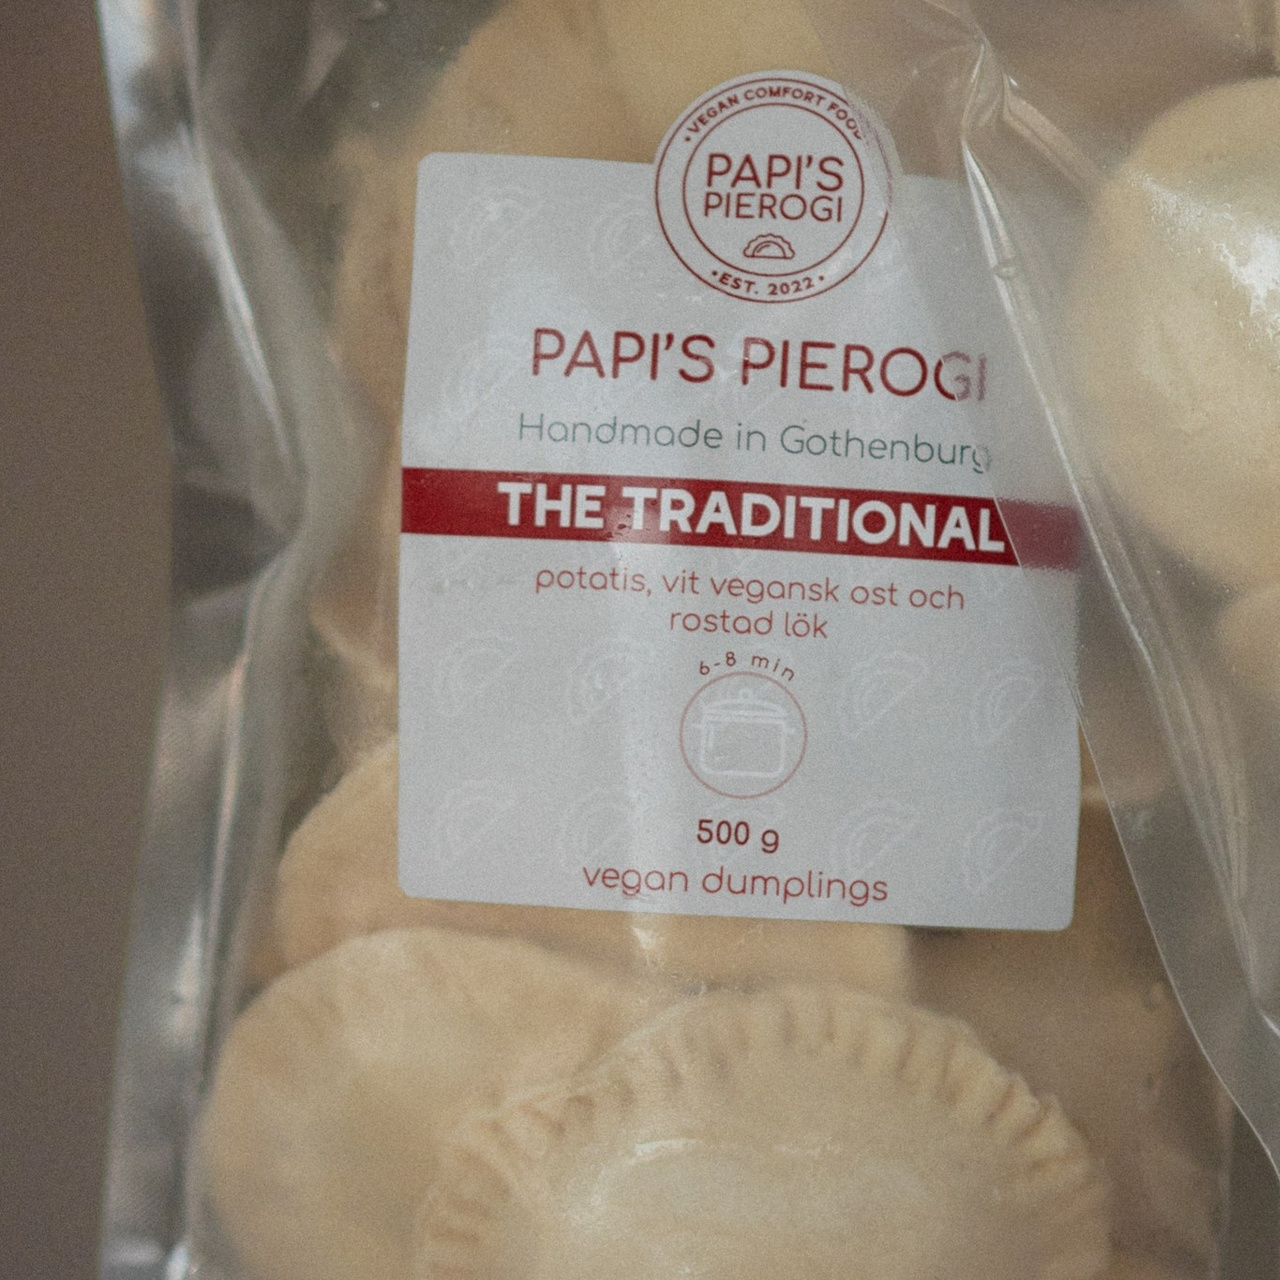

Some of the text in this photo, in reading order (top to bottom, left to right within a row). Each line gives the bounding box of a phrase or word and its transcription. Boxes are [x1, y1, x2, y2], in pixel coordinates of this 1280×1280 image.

[687, 94, 740, 134] VEGAN
[744, 87, 826, 106] COMFORT
[706, 152, 844, 192] PAPI'S
[704, 191, 843, 222] PIEROGI
[718, 271, 815, 295] EST. 2022
[531, 327, 988, 402] PAPI'S PIEROGI
[518, 413, 991, 474] Handmade in Gothenburg
[496, 481, 1005, 553] THE TRADITIONAL
[535, 566, 965, 610] potatis, vit vegansk ost och
[670, 609, 828, 638] rostad lök
[698, 651, 795, 681] 6-8 min
[697, 820, 780, 853] 500 g
[583, 867, 888, 906] vegan dumplings
